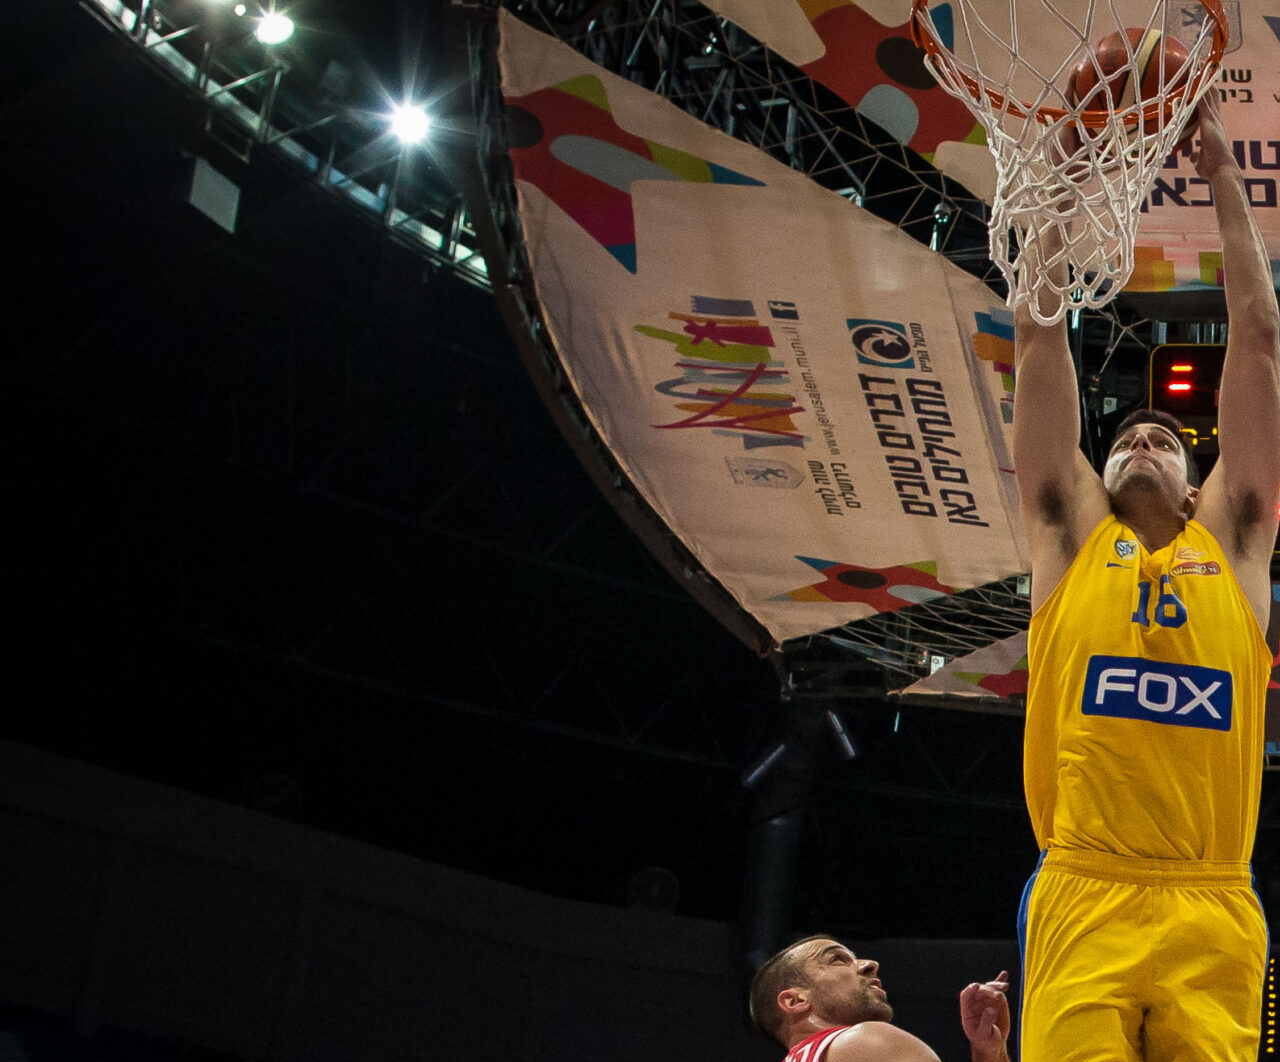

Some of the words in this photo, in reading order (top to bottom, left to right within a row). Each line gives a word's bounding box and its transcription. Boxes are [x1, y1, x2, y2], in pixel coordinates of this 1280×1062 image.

[858, 373, 916, 451] דברים
[885, 453, 938, 518] טובים
[905, 378, 970, 486] מתחילים
[939, 487, 990, 528] כאן
[1095, 668, 1222, 720] FOX
